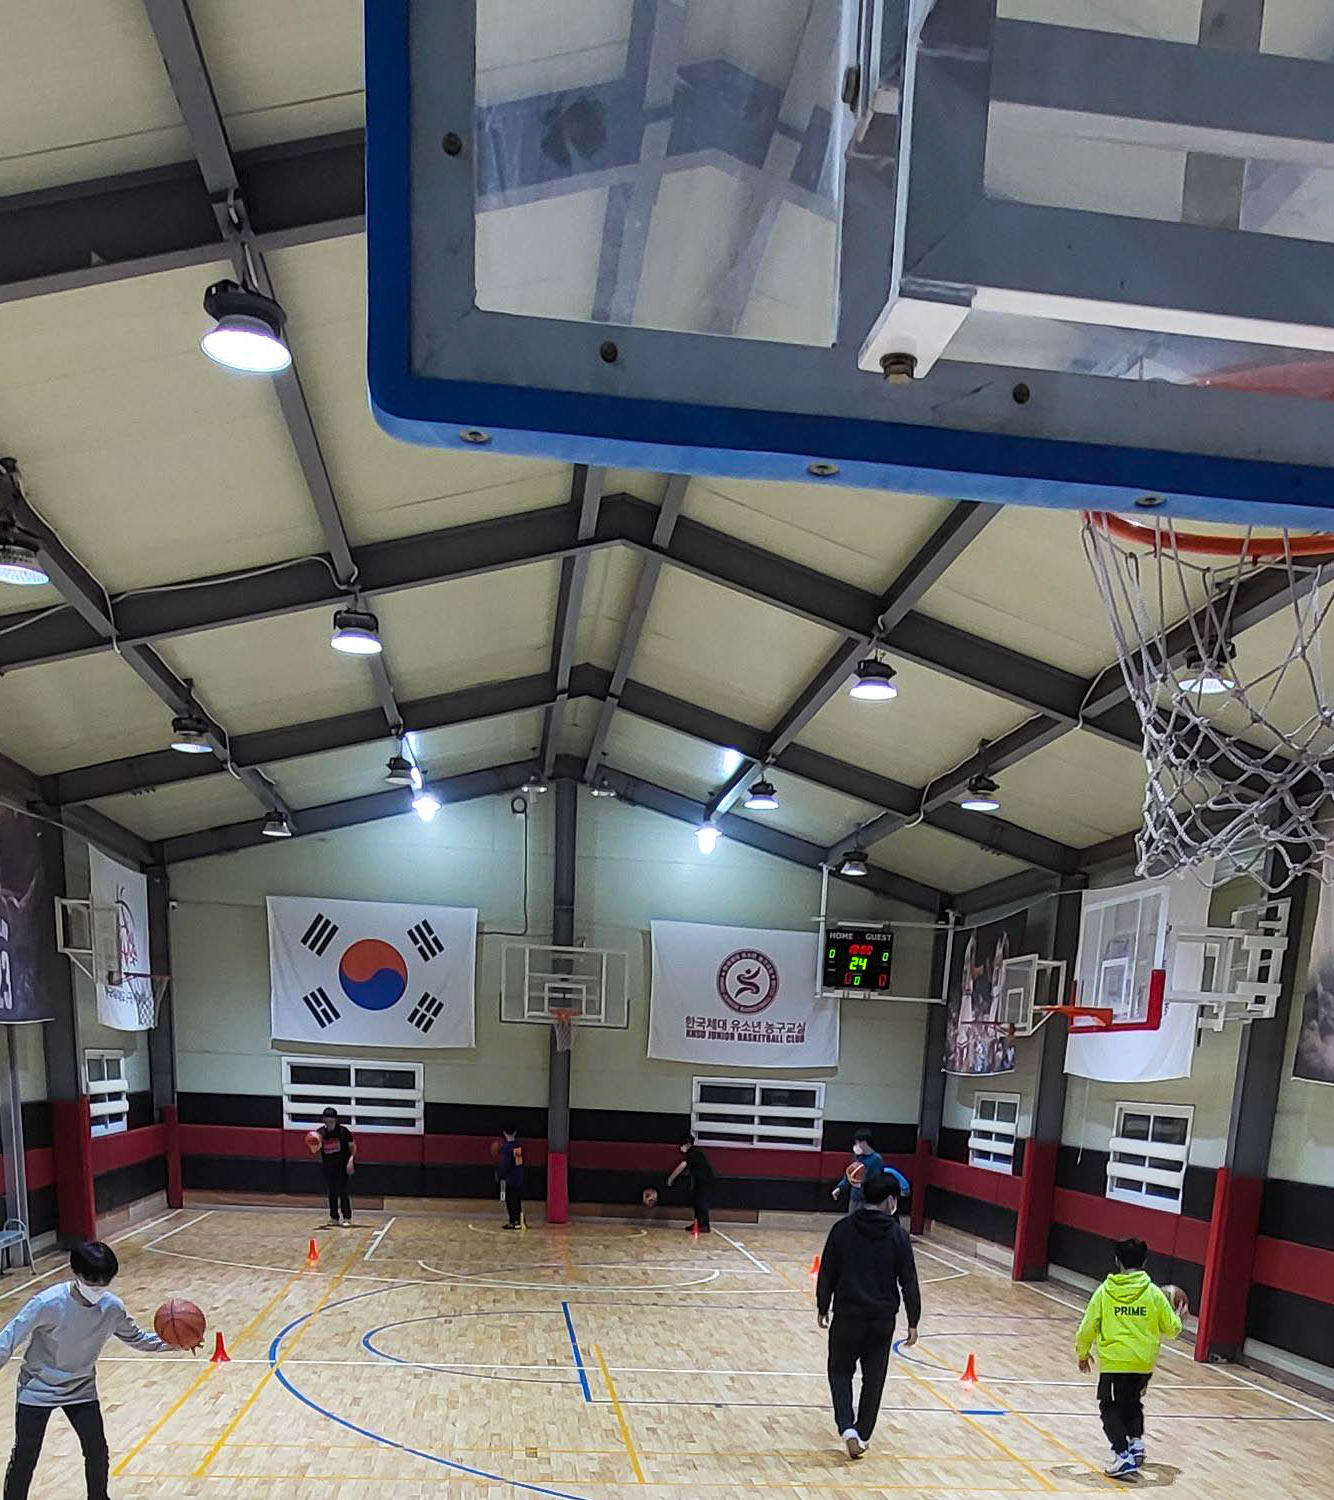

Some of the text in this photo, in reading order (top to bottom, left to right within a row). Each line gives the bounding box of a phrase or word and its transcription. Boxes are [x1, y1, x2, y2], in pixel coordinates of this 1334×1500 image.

[829, 931, 854, 941] HOME
[865, 932, 892, 942] GUEST
[828, 948, 836, 959] 0
[882, 952, 890, 962] 0
[849, 956, 868, 971] 24
[853, 976, 861, 986] 0
[730, 1019, 762, 1034] 유소년
[764, 1021, 806, 1035] 농구교실
[707, 1031, 735, 1041] JUNIOR
[737, 1032, 783, 1044] BASKETBALL
[785, 1034, 805, 1044] CLUB
[1114, 1306, 1147, 1317] PRIME
